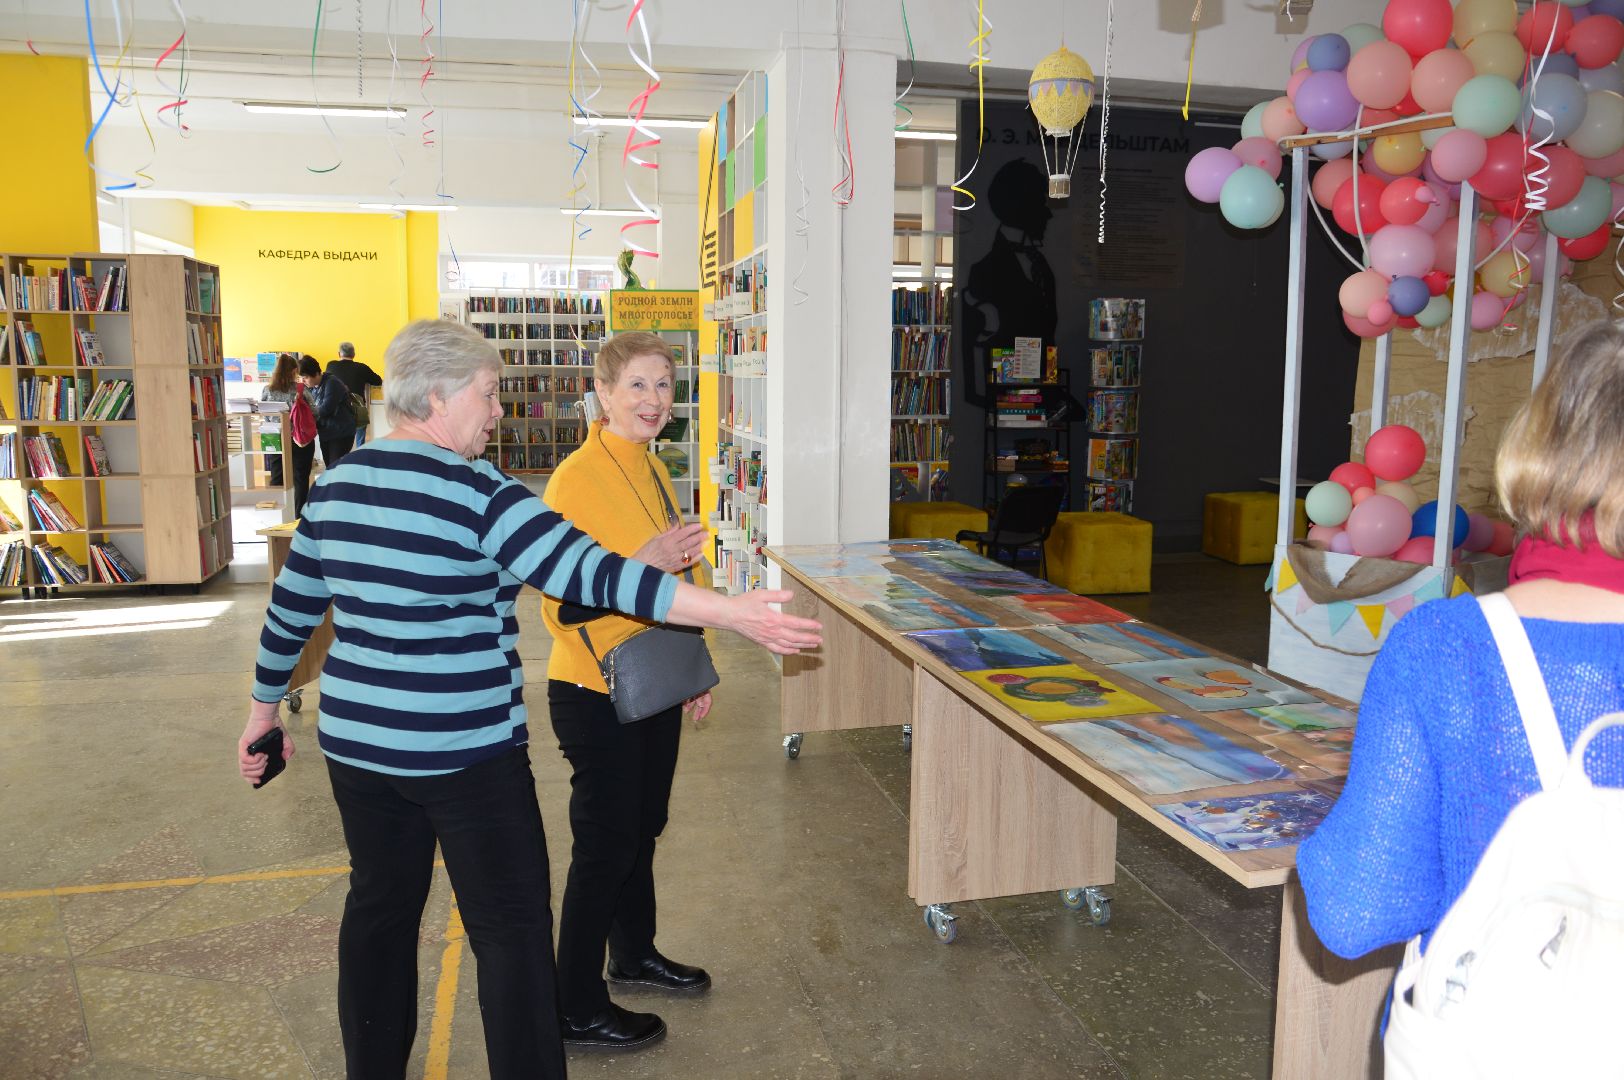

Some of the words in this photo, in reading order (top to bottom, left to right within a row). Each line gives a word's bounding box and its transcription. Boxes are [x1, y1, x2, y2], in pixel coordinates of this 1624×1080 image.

[1002, 128, 1019, 144] Э.
[1027, 129, 1190, 154] МДЕЬШТАМ
[258, 249, 320, 260] КАФЕДРА
[323, 251, 378, 261] ВЫДАЧИ
[618, 295, 657, 306] РОДНОЙ
[660, 297, 693, 306] ЗЕМЛИ
[619, 311, 693, 320] МНОГОГОЛОСЬЕ
